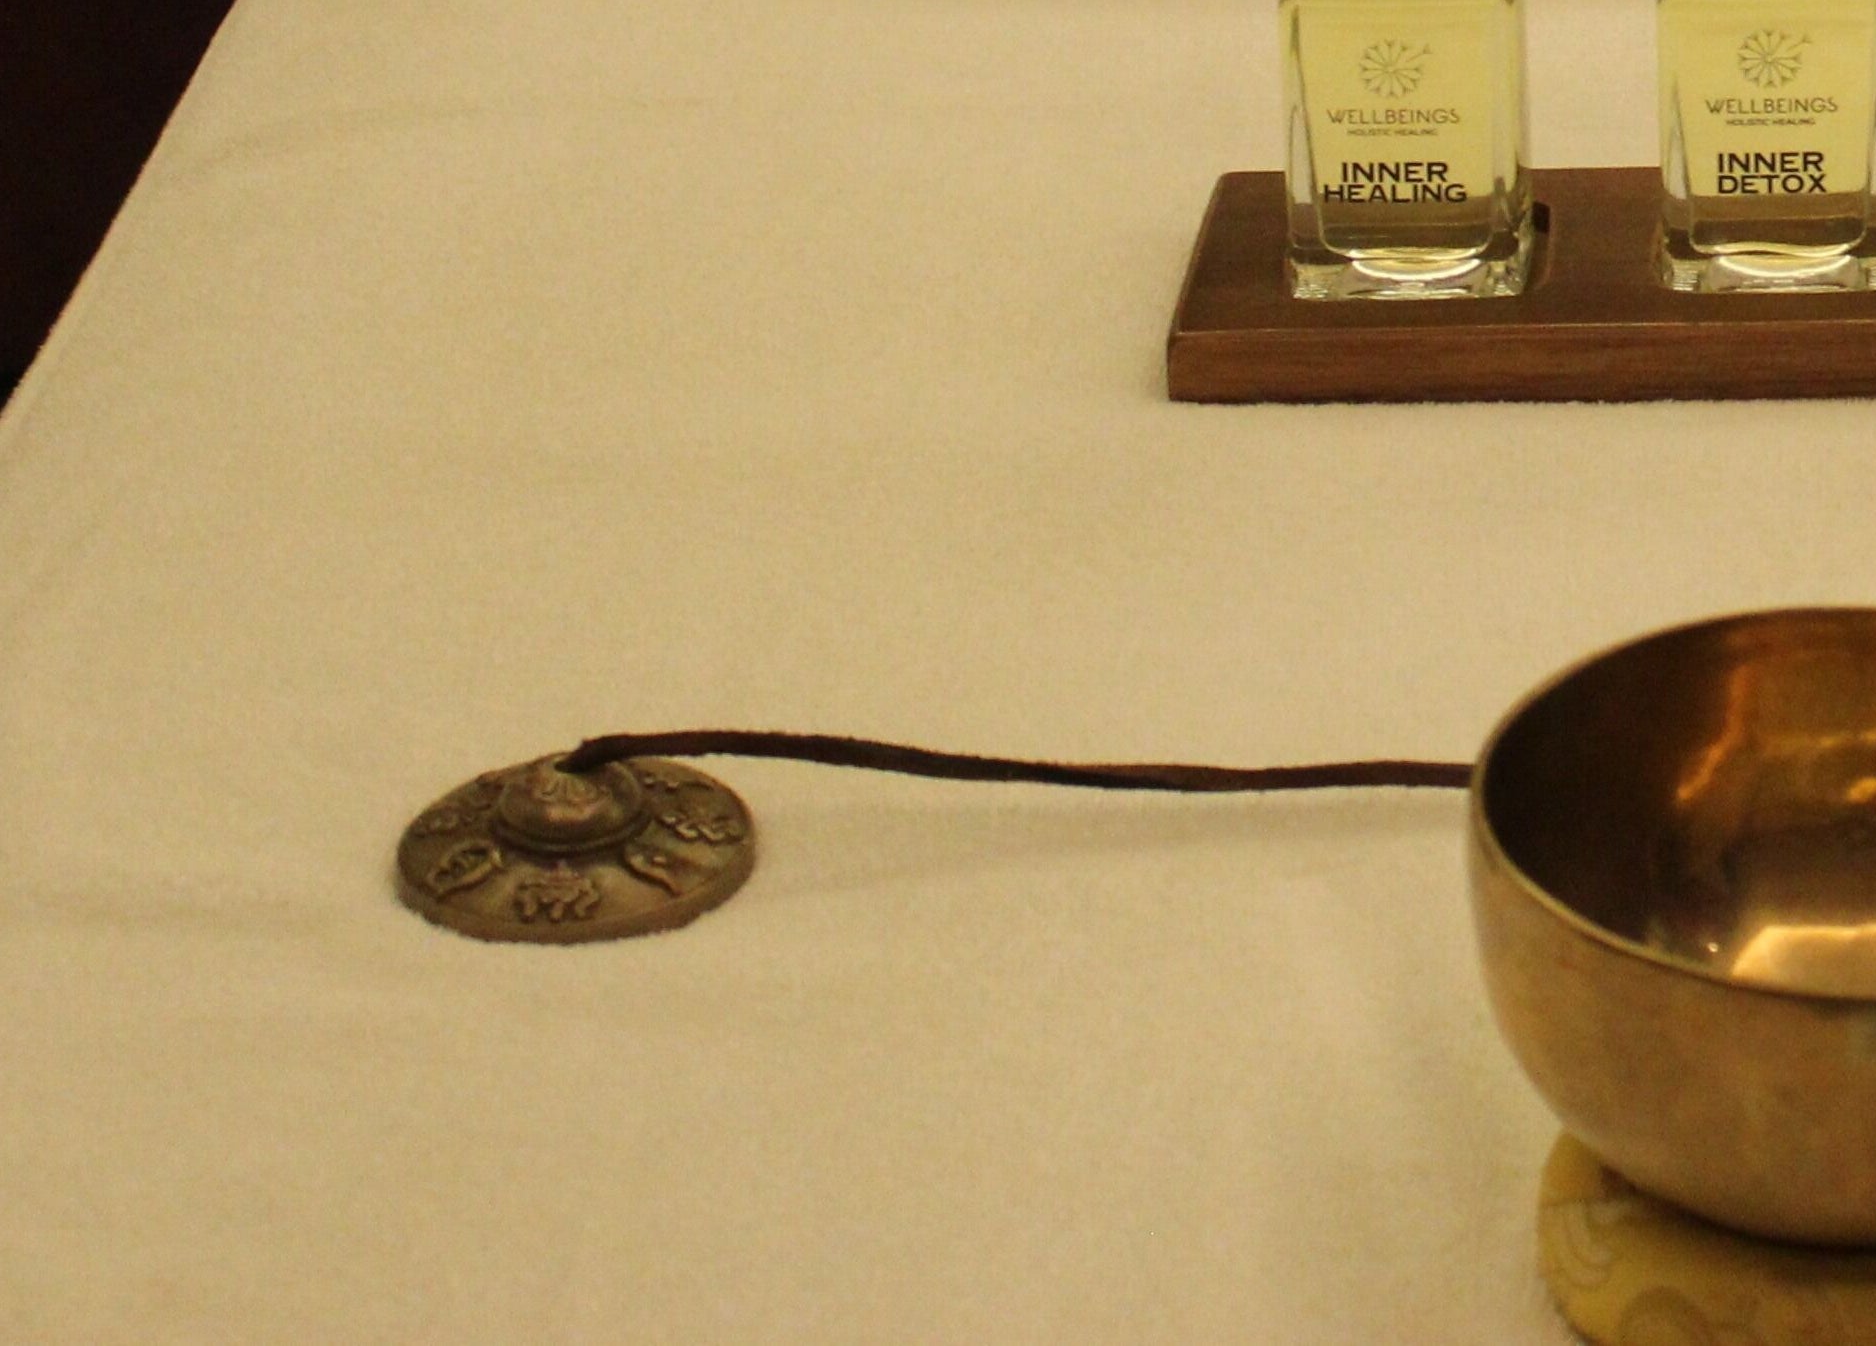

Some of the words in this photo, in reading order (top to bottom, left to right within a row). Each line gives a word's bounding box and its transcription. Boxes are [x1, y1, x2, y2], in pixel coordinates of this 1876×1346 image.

[1705, 97, 1838, 114] WELLBEINGS
[1327, 108, 1460, 124] WELLBEINGS
[1718, 152, 1824, 172] INNER
[1342, 162, 1448, 182] INNER
[1324, 184, 1467, 203] HEALING
[1718, 174, 1826, 194] DETOX
